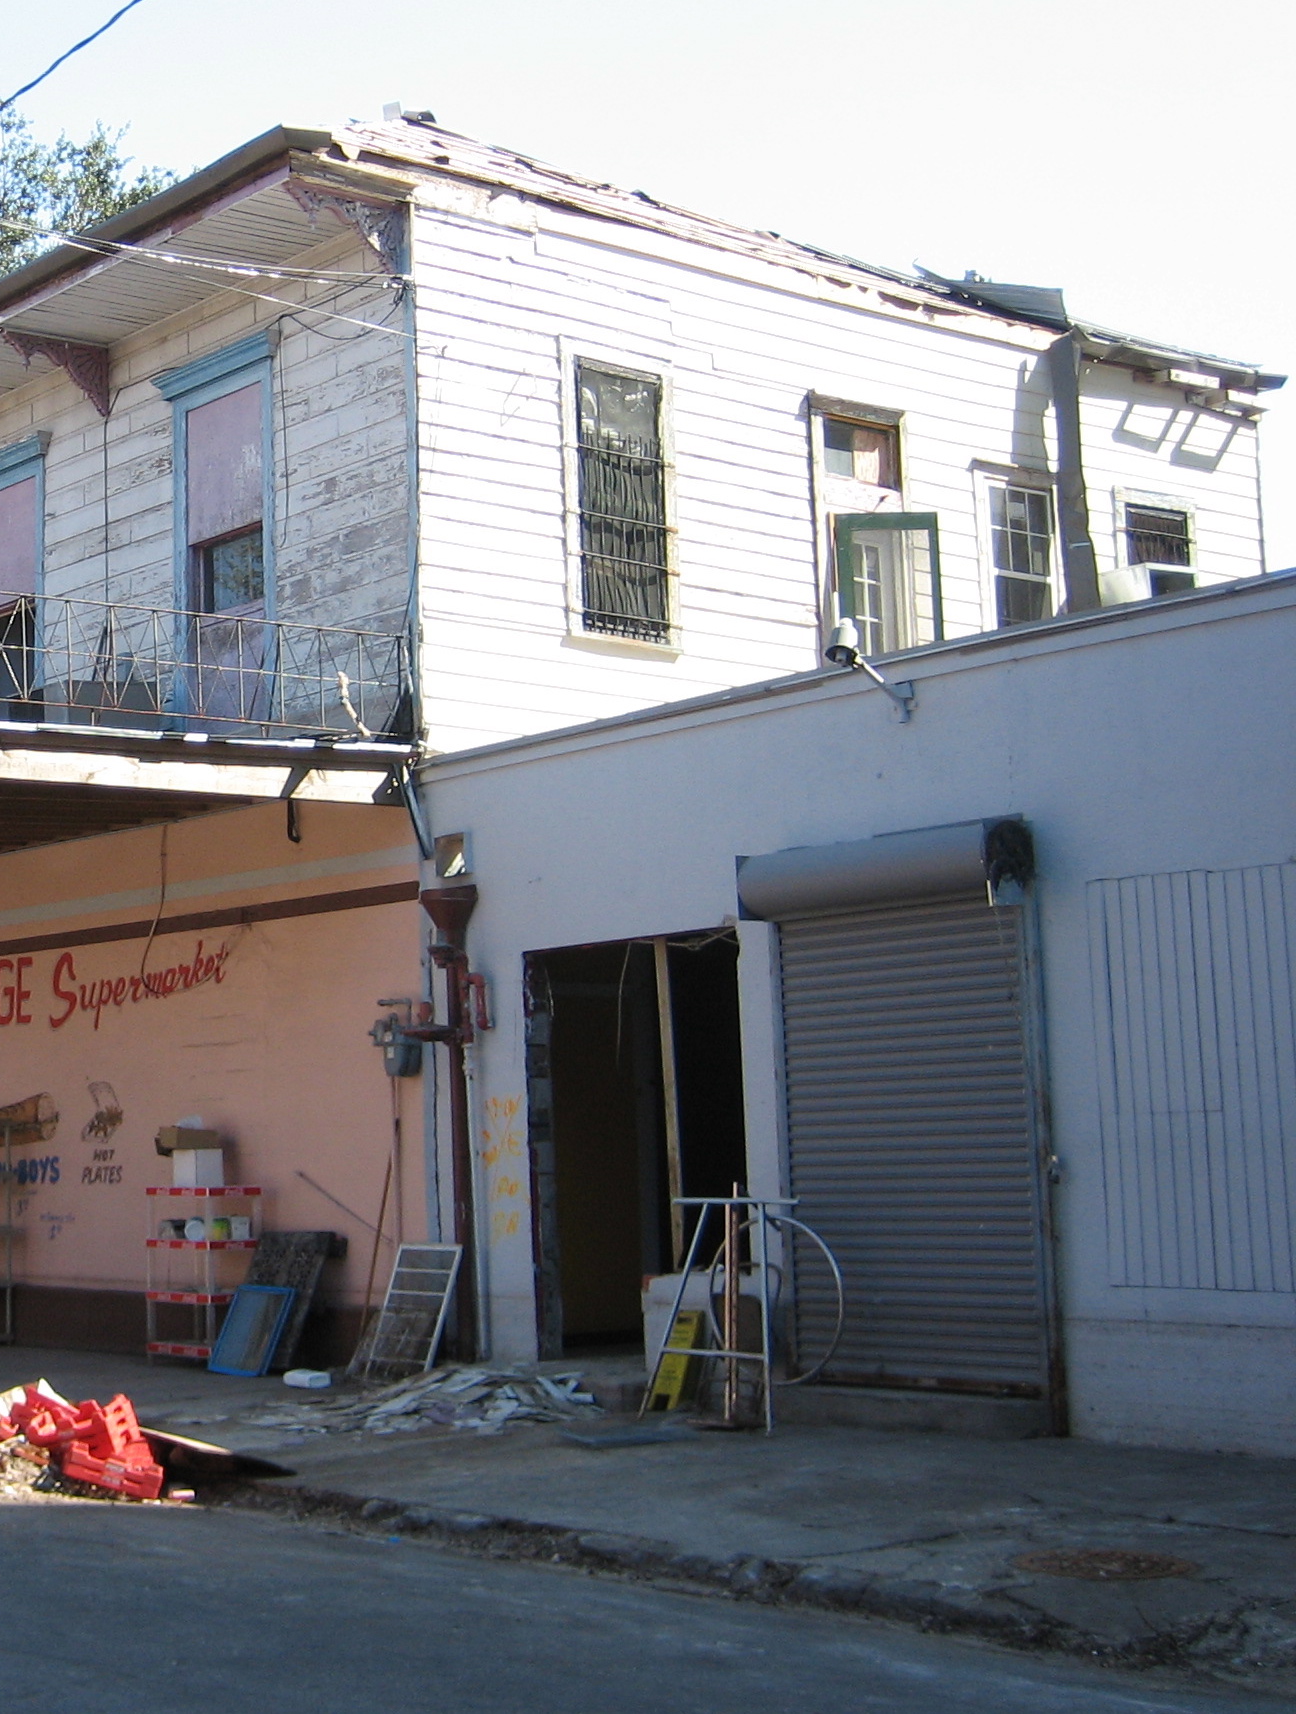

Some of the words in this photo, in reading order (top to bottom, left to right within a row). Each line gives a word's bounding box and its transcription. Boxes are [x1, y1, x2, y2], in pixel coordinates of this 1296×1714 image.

[49, 939, 230, 1031] Supermarket
[92, 1148, 116, 1162] HOT
[81, 1164, 124, 1185] PLATES
